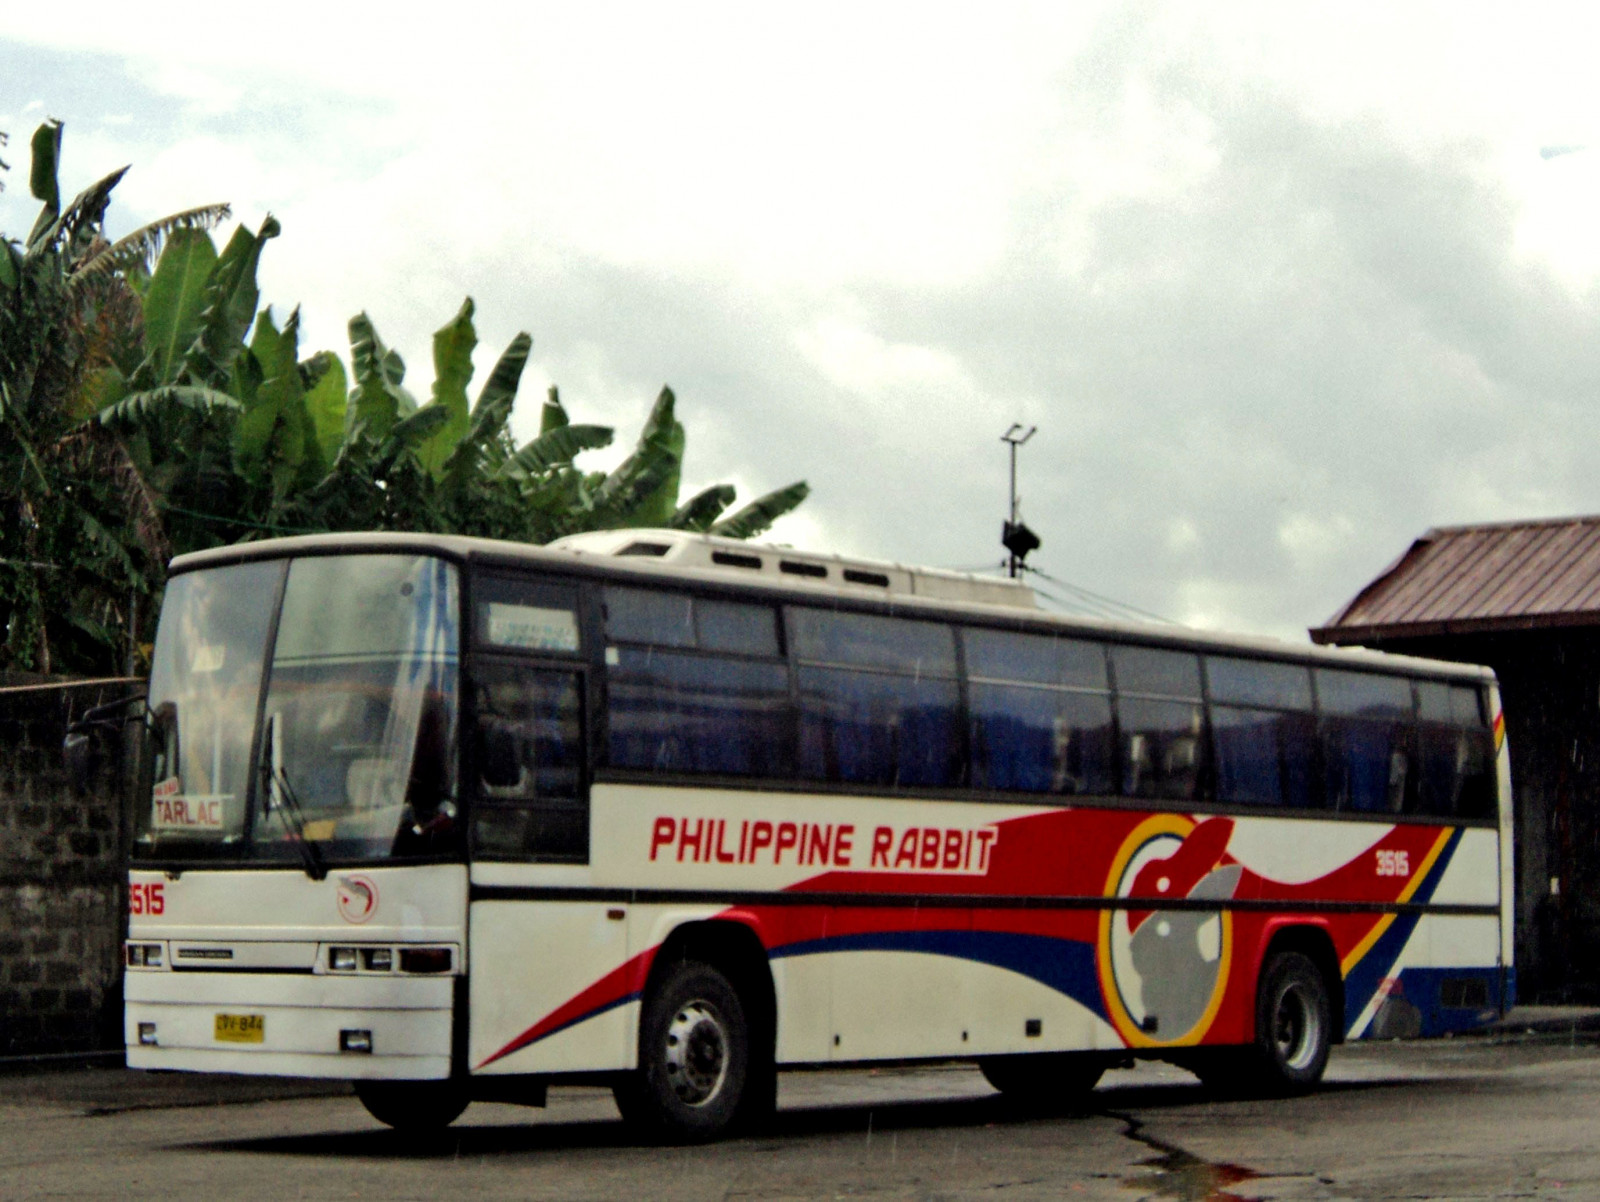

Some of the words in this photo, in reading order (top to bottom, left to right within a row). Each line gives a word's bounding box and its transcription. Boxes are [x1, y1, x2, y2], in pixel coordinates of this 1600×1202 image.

[155, 800, 221, 825] TARLAC
[648, 816, 855, 866] PHILIPPINE
[870, 825, 995, 871] RABBIT
[1376, 849, 1409, 876] 3515
[129, 883, 165, 916] 515
